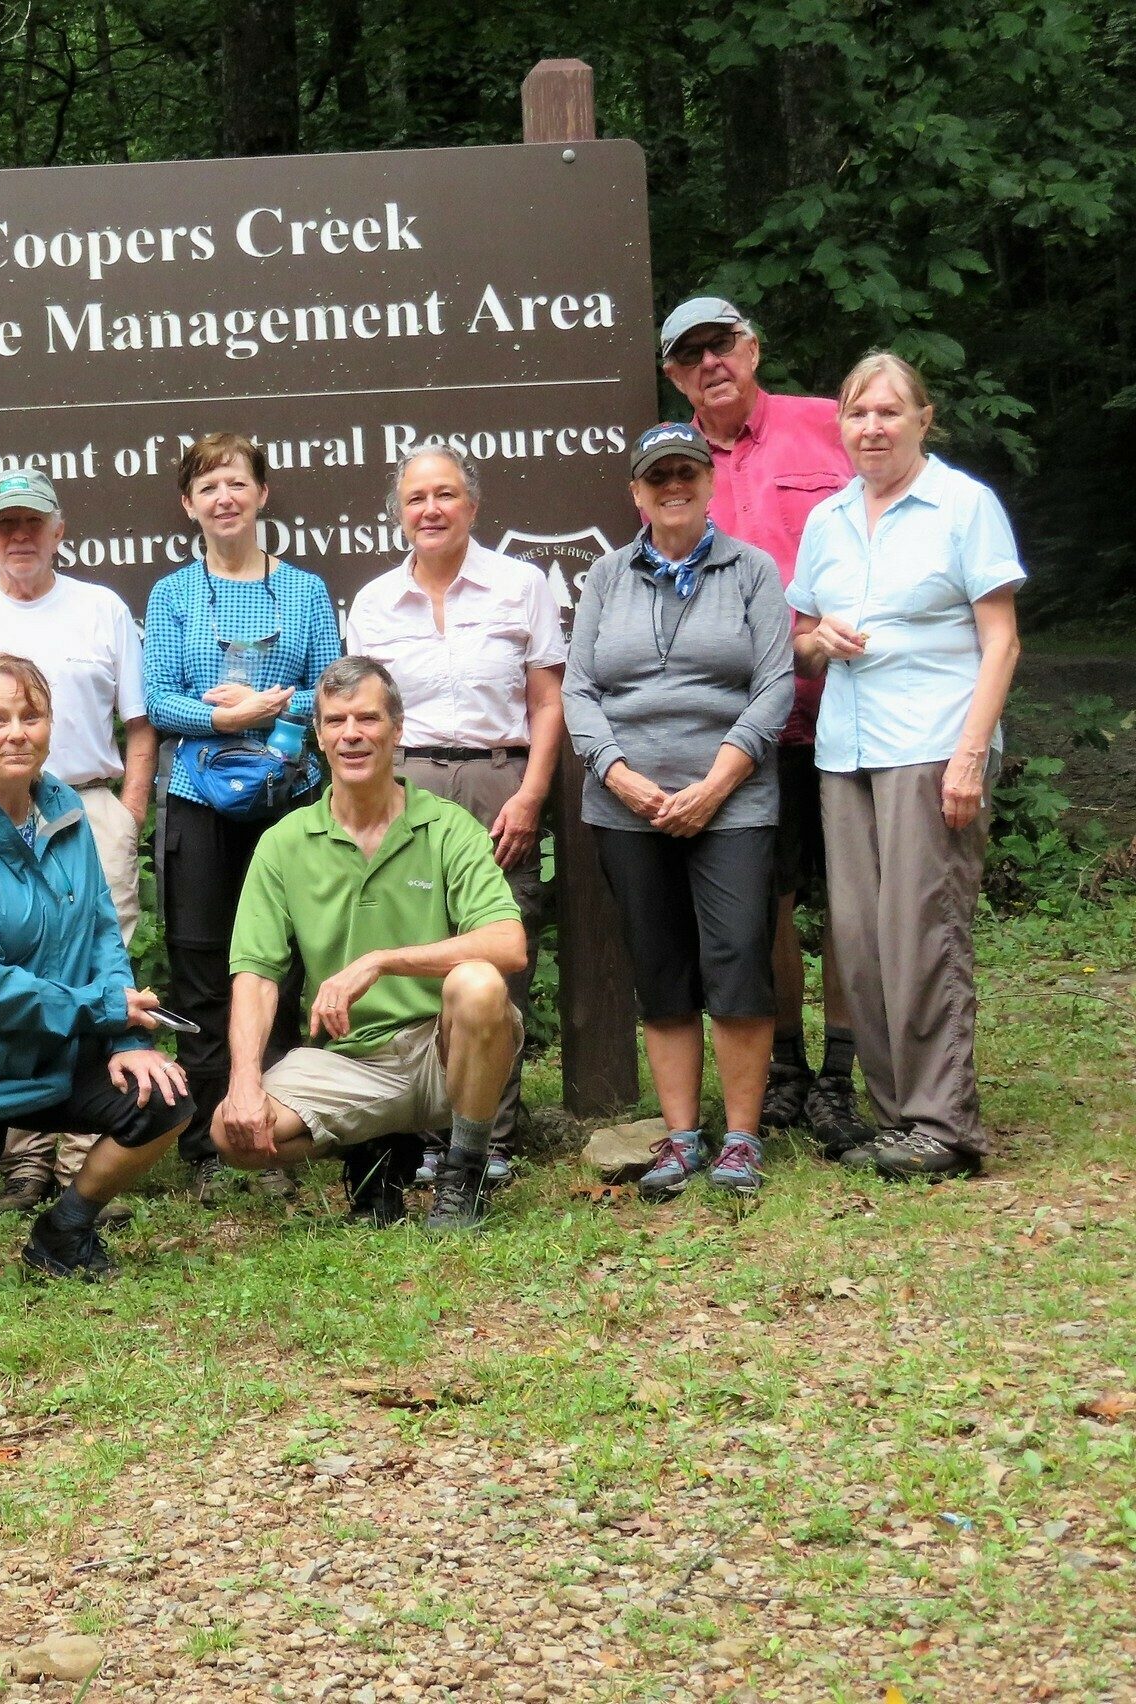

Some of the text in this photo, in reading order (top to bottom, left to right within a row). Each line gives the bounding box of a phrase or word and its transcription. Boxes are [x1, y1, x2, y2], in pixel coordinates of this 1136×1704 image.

[236, 203, 422, 257] Creek
[45, 290, 446, 360] Management
[467, 283, 616, 333] Area
[114, 435, 165, 477] of
[178, 427, 365, 470] ural
[57, 533, 206, 568] source
[255, 512, 415, 557] Divisio
[514, 545, 549, 562] OREST
